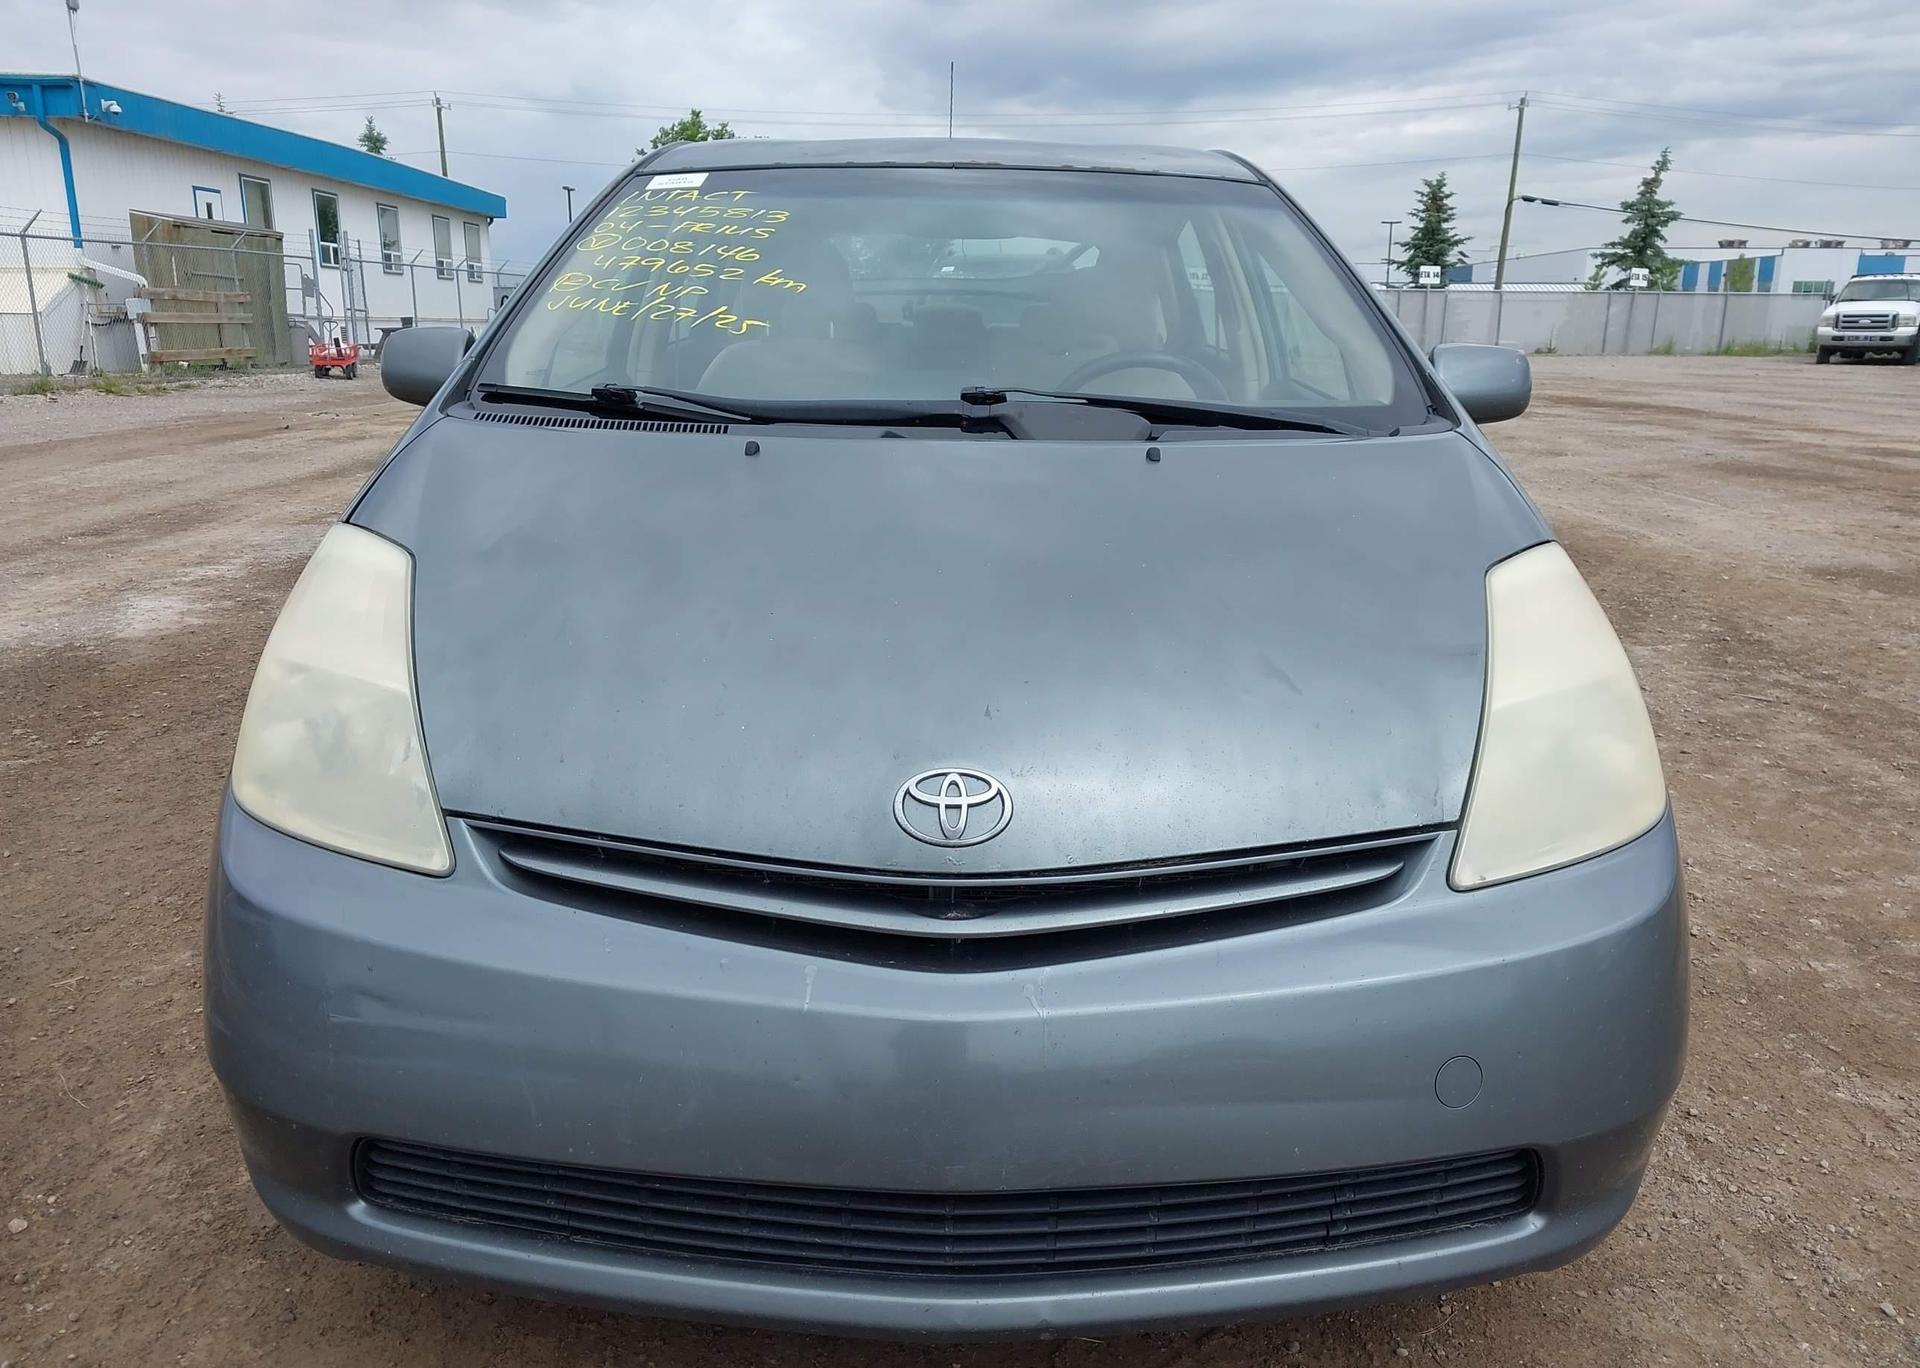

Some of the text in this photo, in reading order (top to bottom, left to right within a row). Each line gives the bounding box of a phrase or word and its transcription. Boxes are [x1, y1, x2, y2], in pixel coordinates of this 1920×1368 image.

[621, 190, 757, 204] INTACT
[605, 206, 790, 222] 12345813
[594, 255, 807, 293] 479652 km
